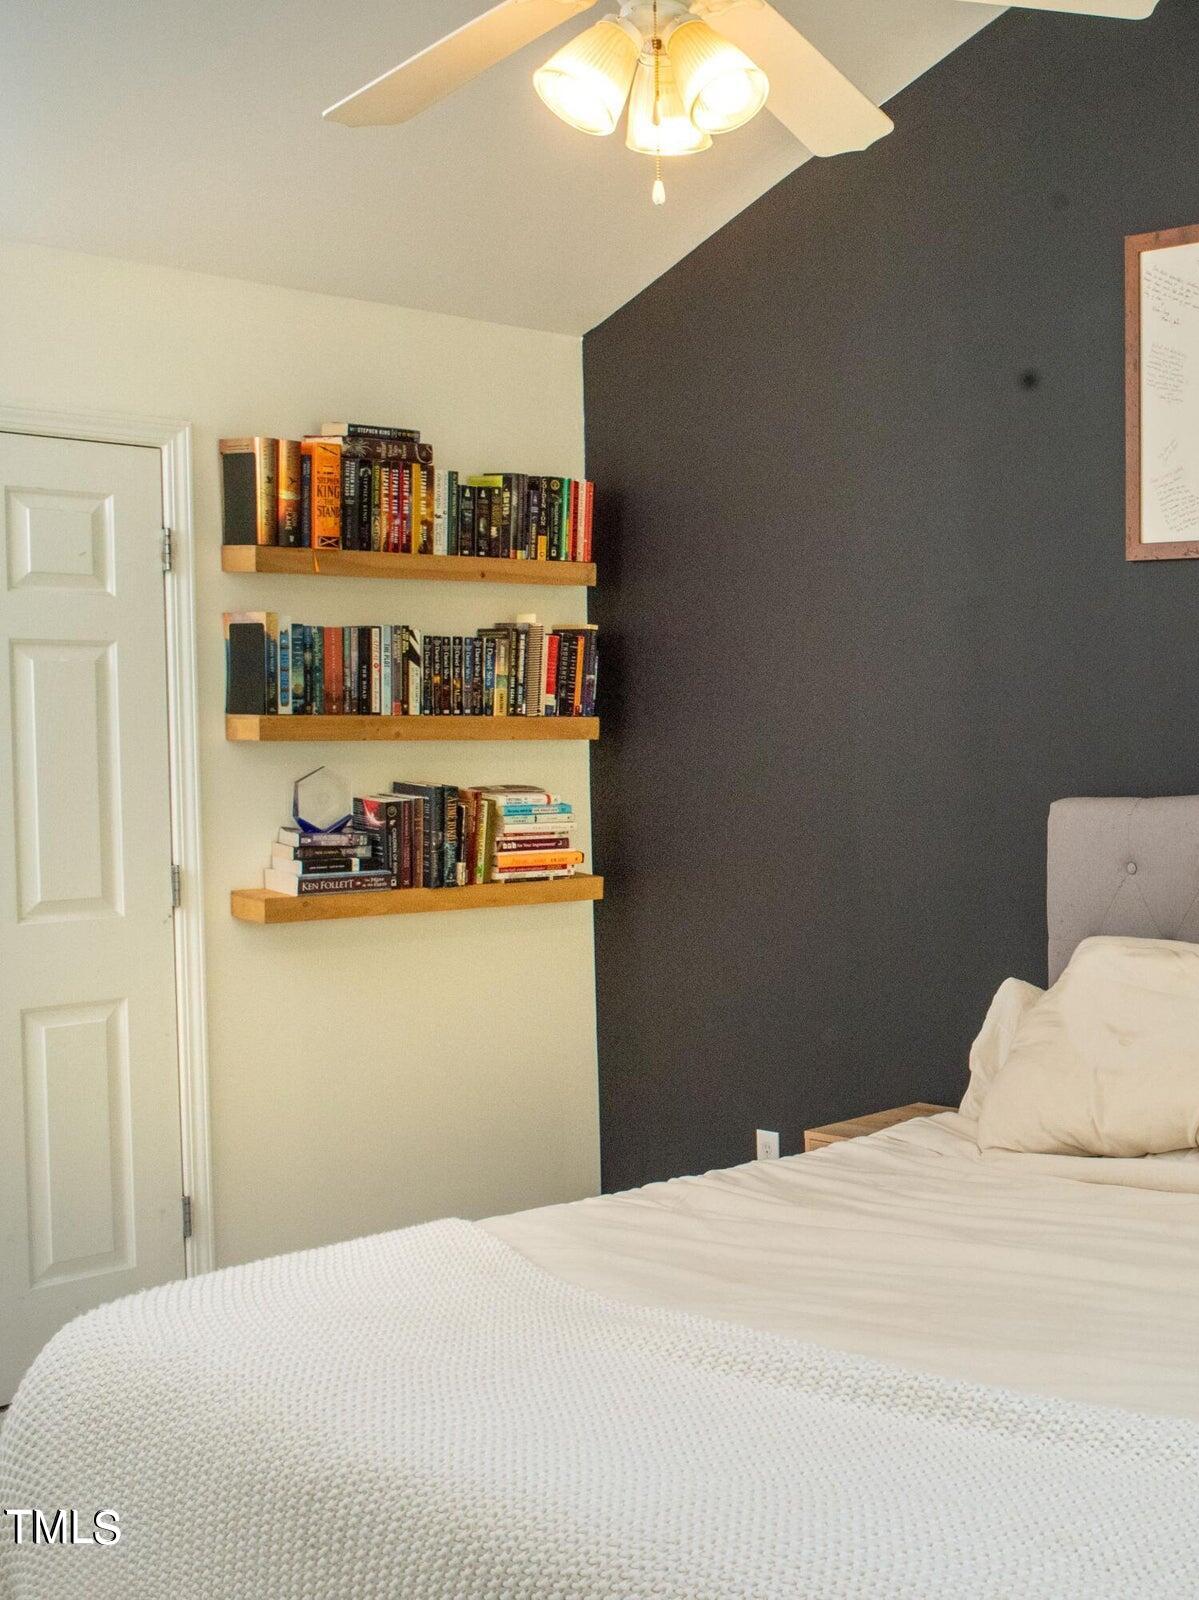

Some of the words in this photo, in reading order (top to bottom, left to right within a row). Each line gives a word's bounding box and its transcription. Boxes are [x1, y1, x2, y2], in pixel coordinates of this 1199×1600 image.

[317, 485, 339, 499] KING
[486, 648, 494, 669] Daniel
[560, 642, 569, 683] ENDURANCE
[447, 803, 457, 820] TIME
[302, 881, 319, 891] KEN
[320, 879, 354, 889] FOLLETT
